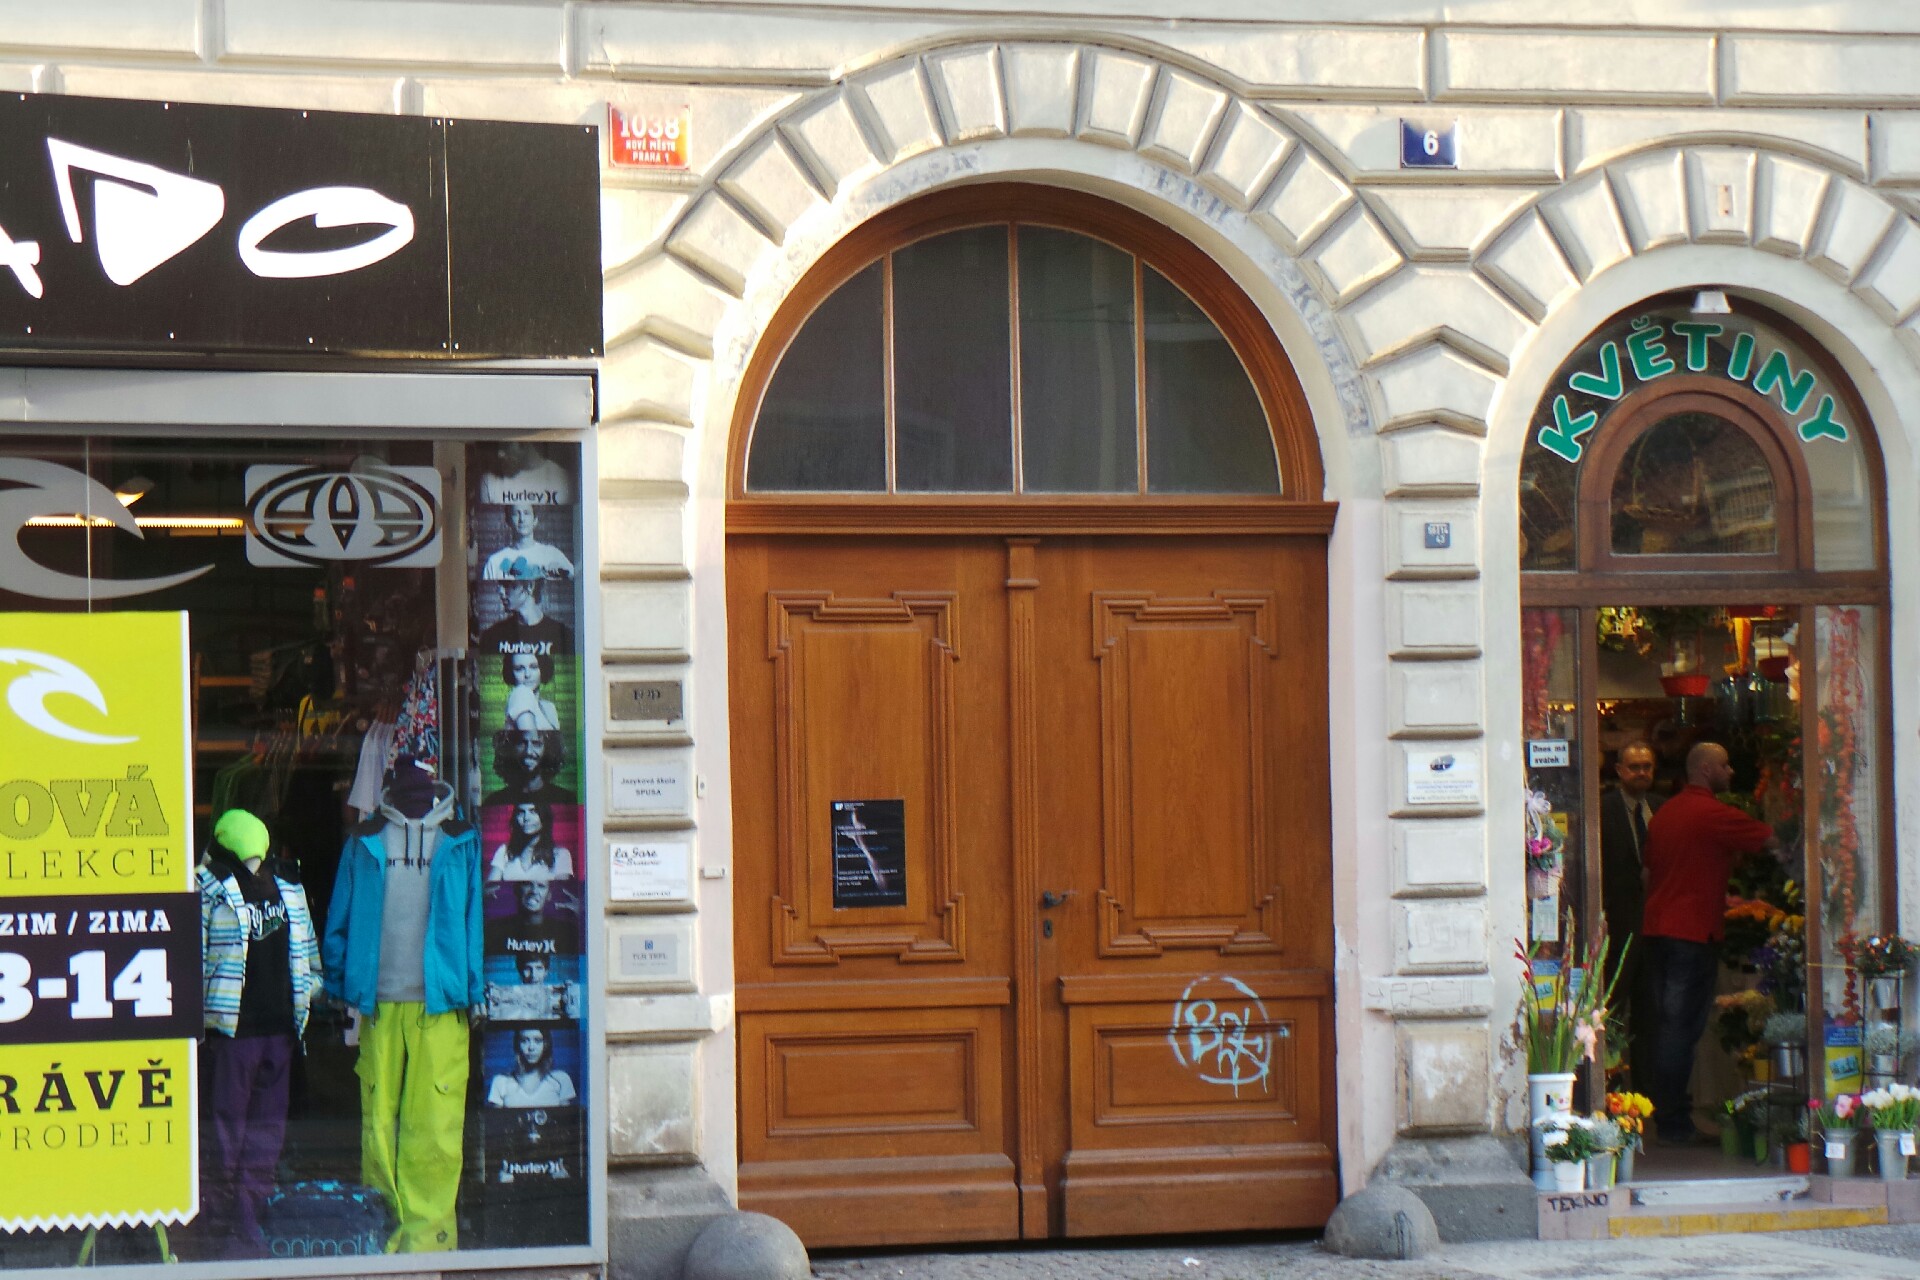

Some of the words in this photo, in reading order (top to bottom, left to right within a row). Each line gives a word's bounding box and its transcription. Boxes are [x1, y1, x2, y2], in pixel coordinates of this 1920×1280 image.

[619, 112, 680, 140] 1038
[1423, 129, 1439, 156] 6
[632, 151, 661, 163] PRAHA
[1537, 315, 1848, 463] KVĚTINY
[502, 489, 544, 503] Hurley
[499, 640, 539, 655] Hurley
[6, 848, 170, 880] LEKCE
[0, 912, 57, 937] ZIM
[89, 909, 171, 934] ZIMA
[507, 937, 543, 953] Hurley
[0, 1119, 173, 1150] RODEJI
[509, 1162, 548, 1174] Hurley
[271, 1234, 361, 1257] animal
